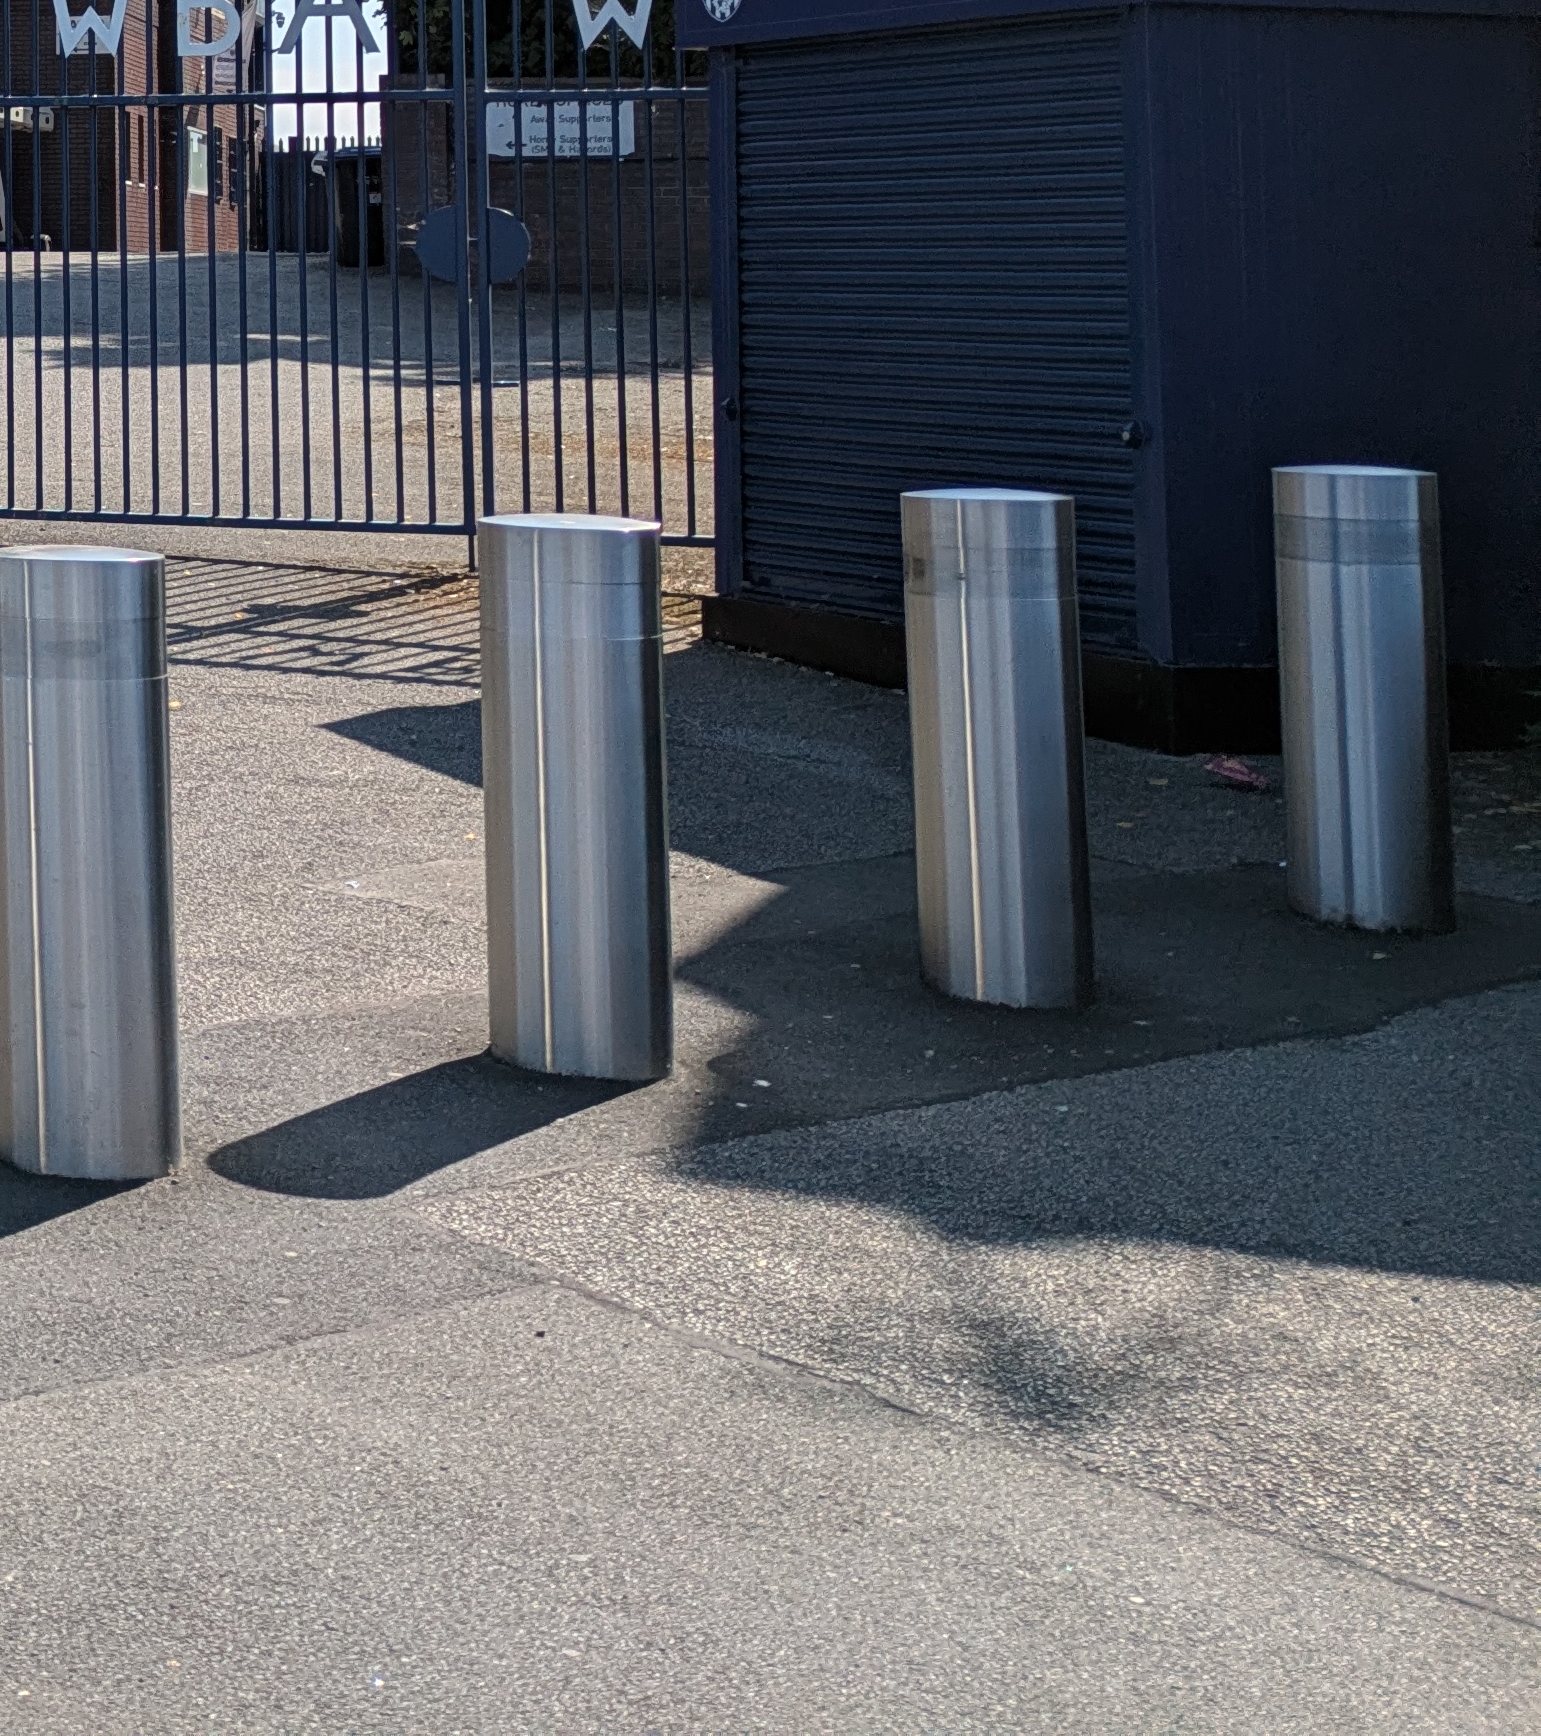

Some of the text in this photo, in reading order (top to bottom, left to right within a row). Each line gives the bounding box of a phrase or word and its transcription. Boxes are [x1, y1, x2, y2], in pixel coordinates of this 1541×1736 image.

[530, 114, 611, 124] Awa Supprters
[559, 134, 612, 144] Supprters
